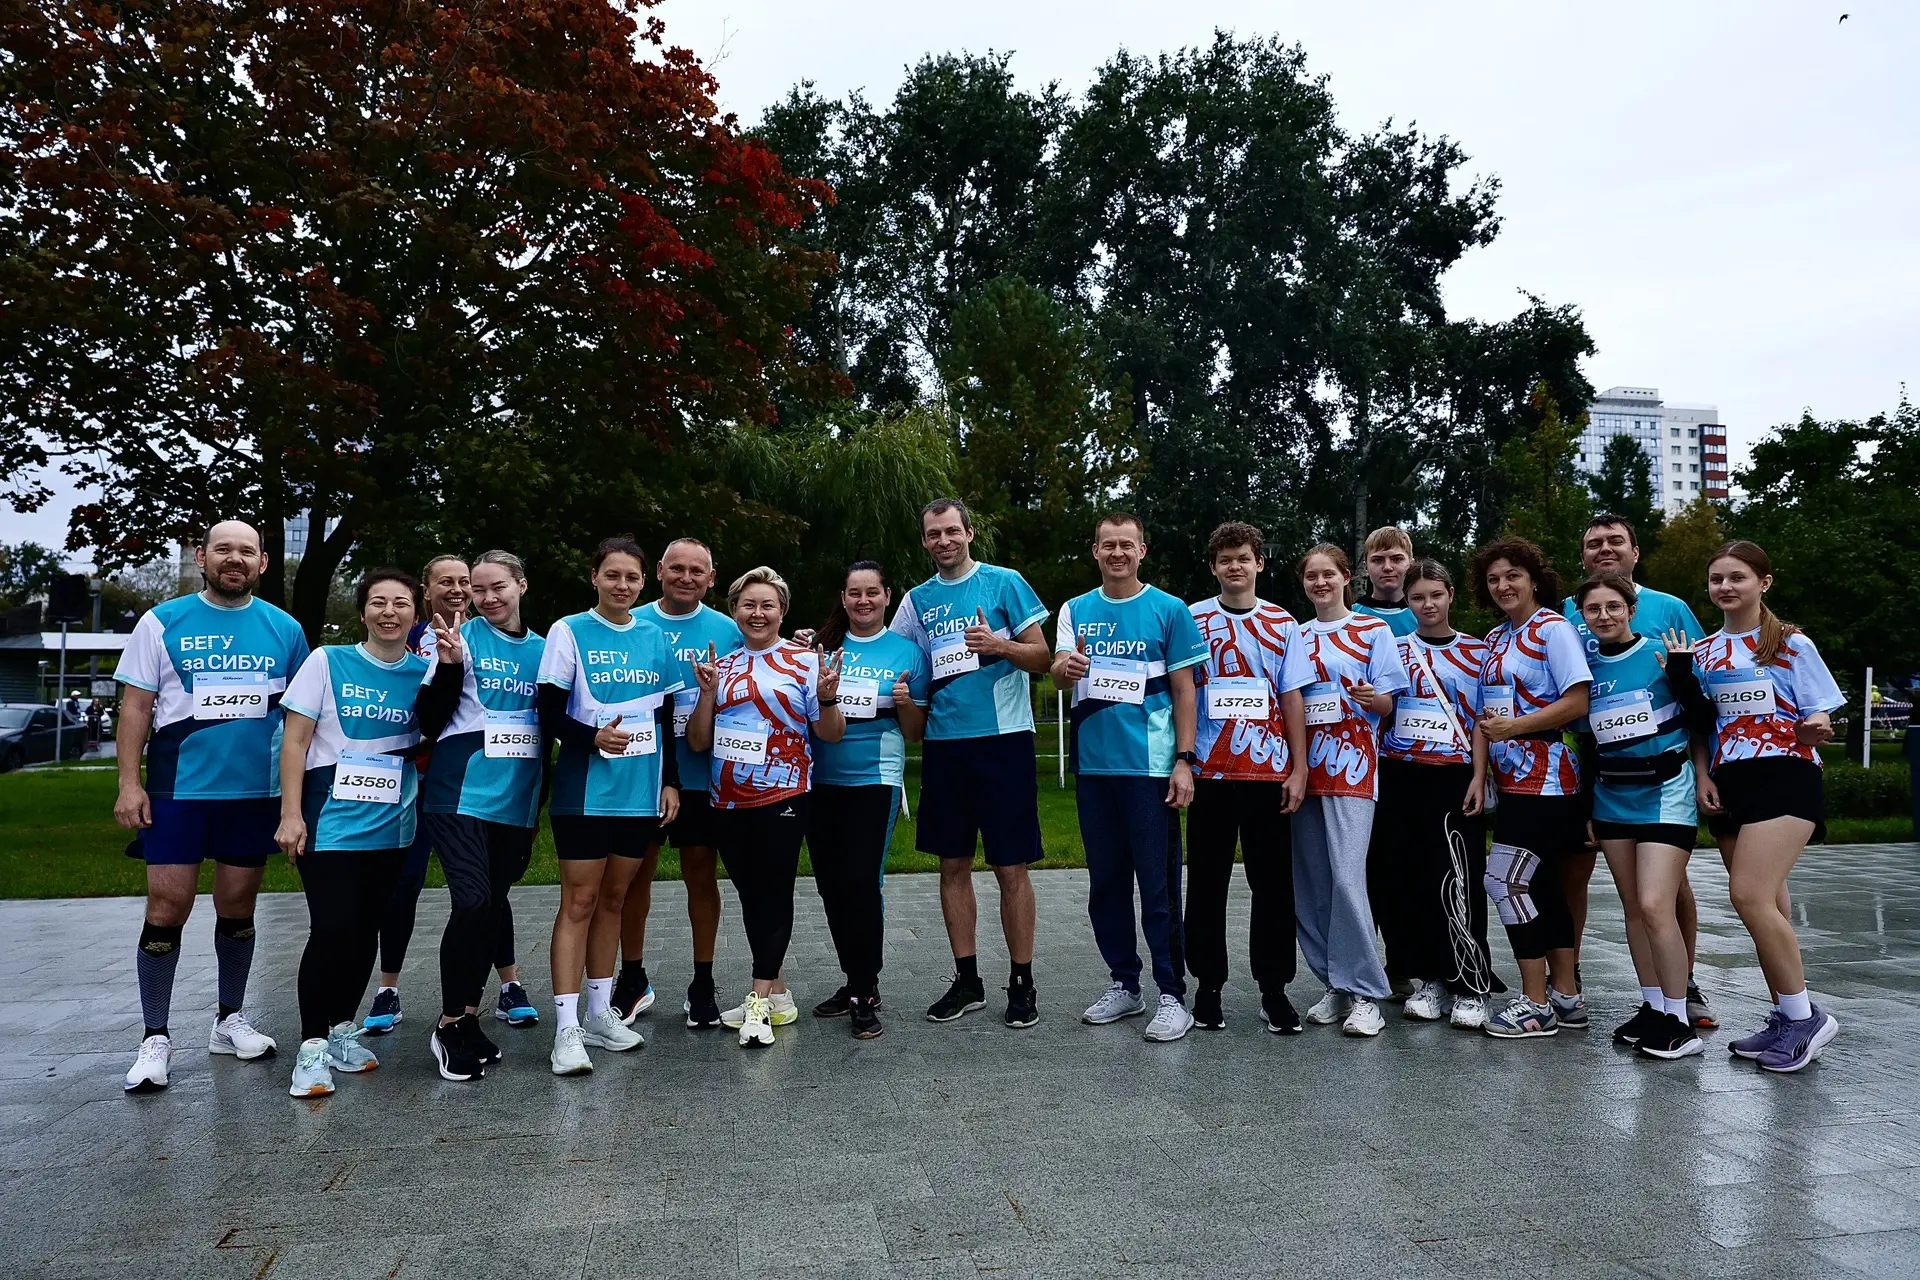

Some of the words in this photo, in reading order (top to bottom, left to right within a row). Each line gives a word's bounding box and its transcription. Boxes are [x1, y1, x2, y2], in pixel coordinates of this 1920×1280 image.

[1078, 622, 1117, 637] БЕГУ
[180, 635, 235, 652] БЕГУ
[1095, 640, 1146, 656] СИБУР
[182, 659, 204, 671] за
[208, 655, 276, 671] СИБУР
[588, 650, 629, 665] БЕГУ
[934, 651, 974, 668] 13609
[480, 657, 520, 675] БЕГУ
[590, 671, 611, 684] за
[612, 668, 660, 686] СИБУР
[1092, 677, 1140, 692] 13729
[341, 683, 389, 703] БЕГУ
[481, 677, 501, 690] за
[503, 677, 539, 697] СИБ
[1590, 679, 1618, 698] ЕГУ
[201, 694, 262, 707] 13479
[835, 694, 873, 707] 3613
[1213, 697, 1264, 708] 13723
[1713, 690, 1767, 704] 12169
[341, 705, 363, 717] за
[365, 704, 419, 725] СИБУ
[1304, 701, 1337, 714] 3722
[1486, 706, 1510, 717] 712
[1401, 717, 1448, 732] 13714
[1596, 711, 1649, 732] 13466
[489, 733, 540, 745] 13585
[628, 730, 653, 744] 463
[716, 736, 763, 752] 13623
[339, 774, 397, 790] 13580
